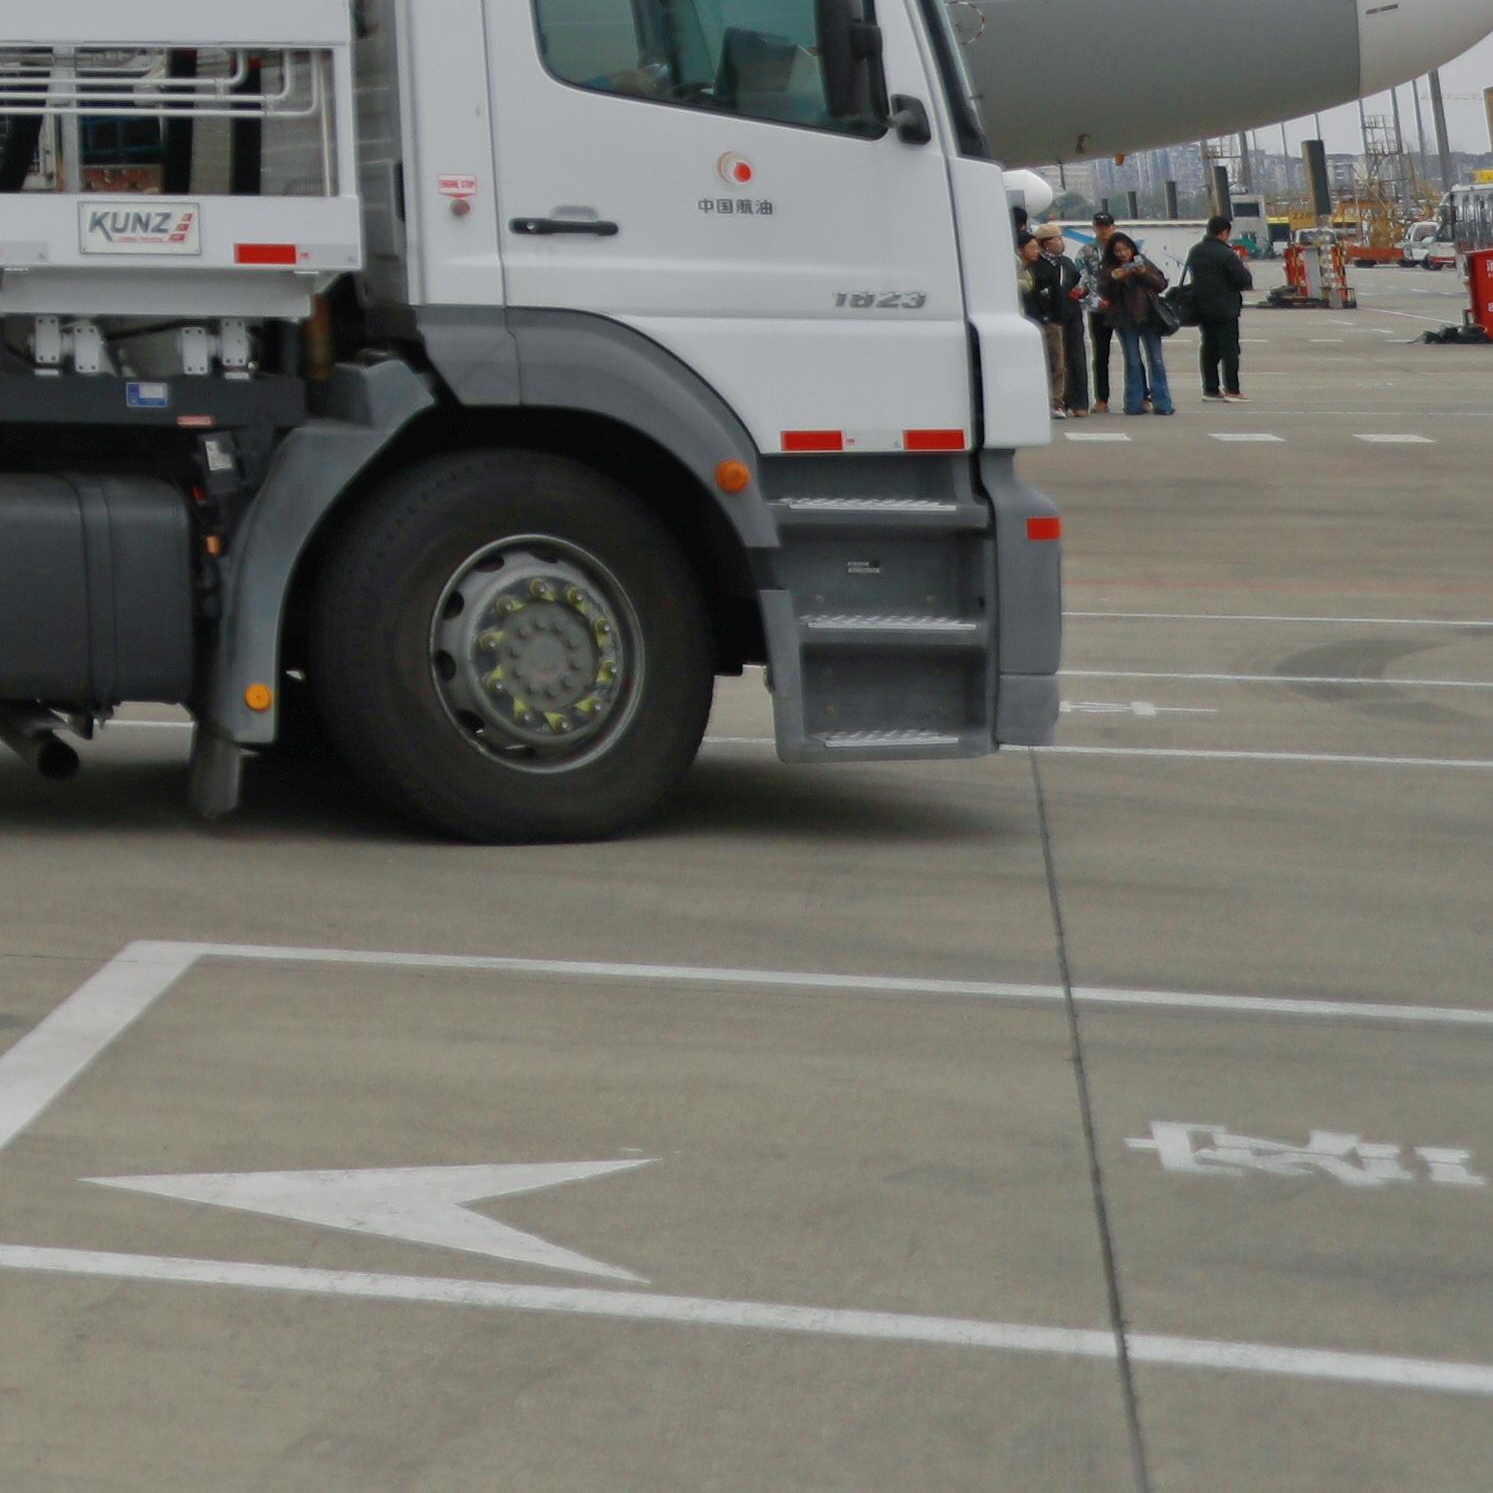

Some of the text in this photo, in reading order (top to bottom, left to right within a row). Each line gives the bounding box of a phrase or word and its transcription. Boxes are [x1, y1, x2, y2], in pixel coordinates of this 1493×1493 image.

[698, 198, 773, 215] 中国航油
[88, 211, 172, 242] KUNZ
[833, 291, 927, 309] 1823
